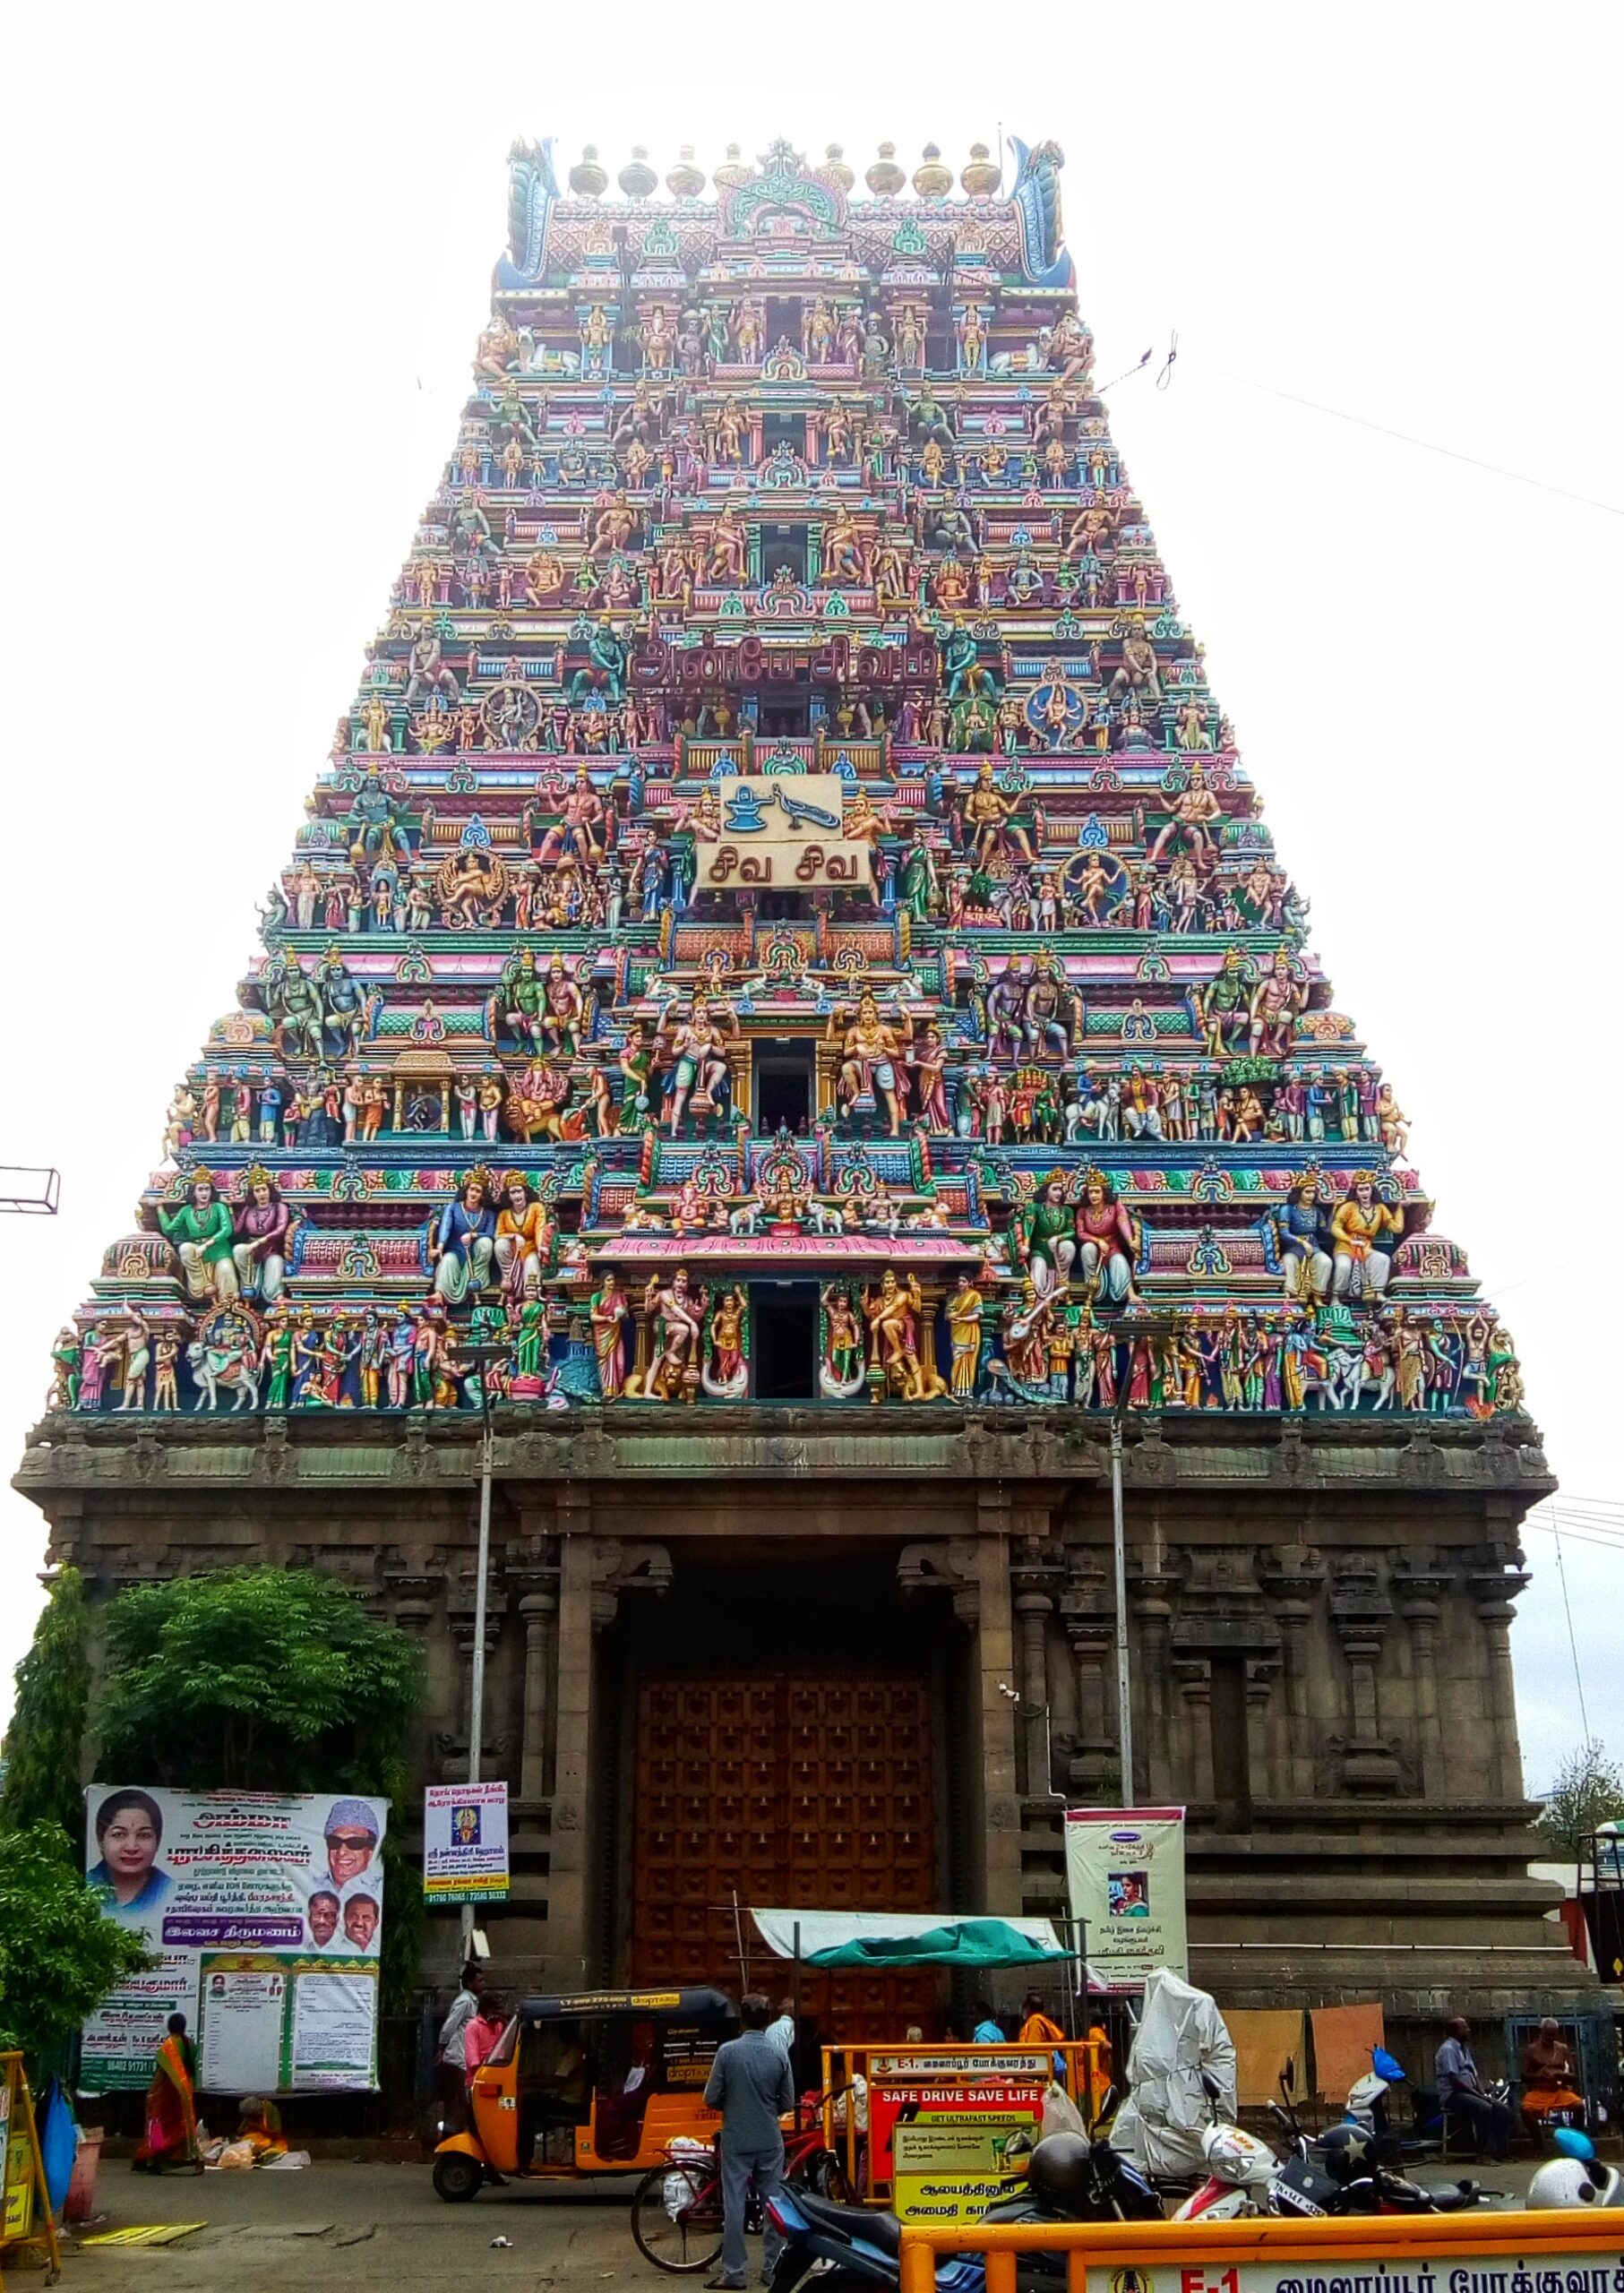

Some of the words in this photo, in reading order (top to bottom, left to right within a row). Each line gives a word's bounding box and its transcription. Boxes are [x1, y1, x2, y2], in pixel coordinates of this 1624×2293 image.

[709, 845, 772, 883] சிவ
[795, 844, 857, 881] சிவ
[165, 1926, 220, 1937] இலவச
[224, 1925, 302, 1939] திருமணம்
[882, 2090, 918, 2102] SAFE
[922, 2090, 964, 2101] DRIVE
[967, 2090, 1004, 2101] SAVE
[1008, 2089, 1038, 2101] LIFE
